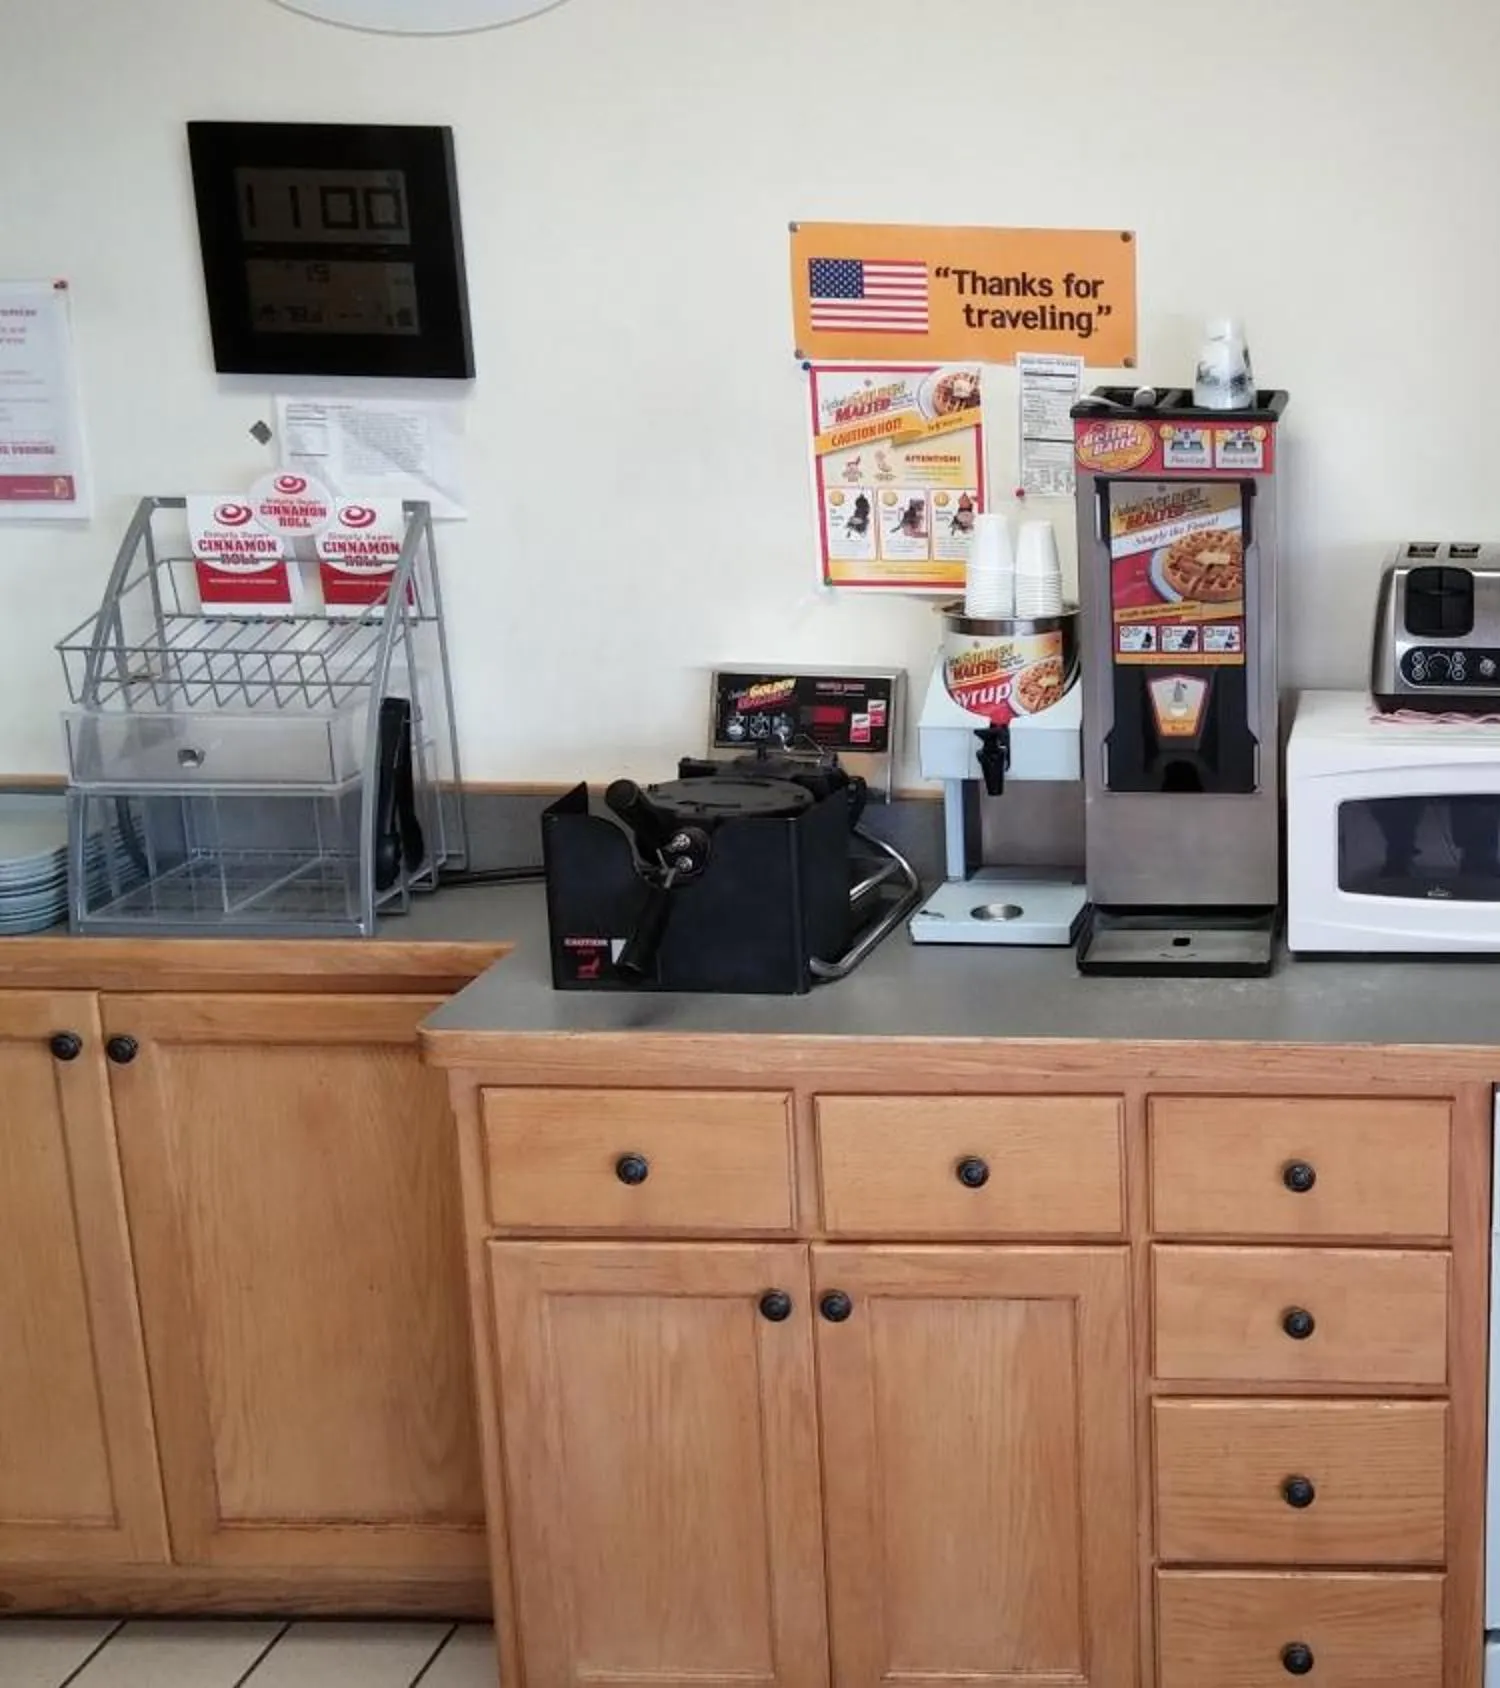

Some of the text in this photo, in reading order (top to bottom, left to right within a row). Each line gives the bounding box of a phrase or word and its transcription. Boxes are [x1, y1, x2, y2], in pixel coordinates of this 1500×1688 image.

[1063, 272, 1105, 298] for
[259, 505, 327, 518] CINNAMON
[198, 540, 277, 552] CINNAMON
[323, 541, 401, 555] CINNAMON
